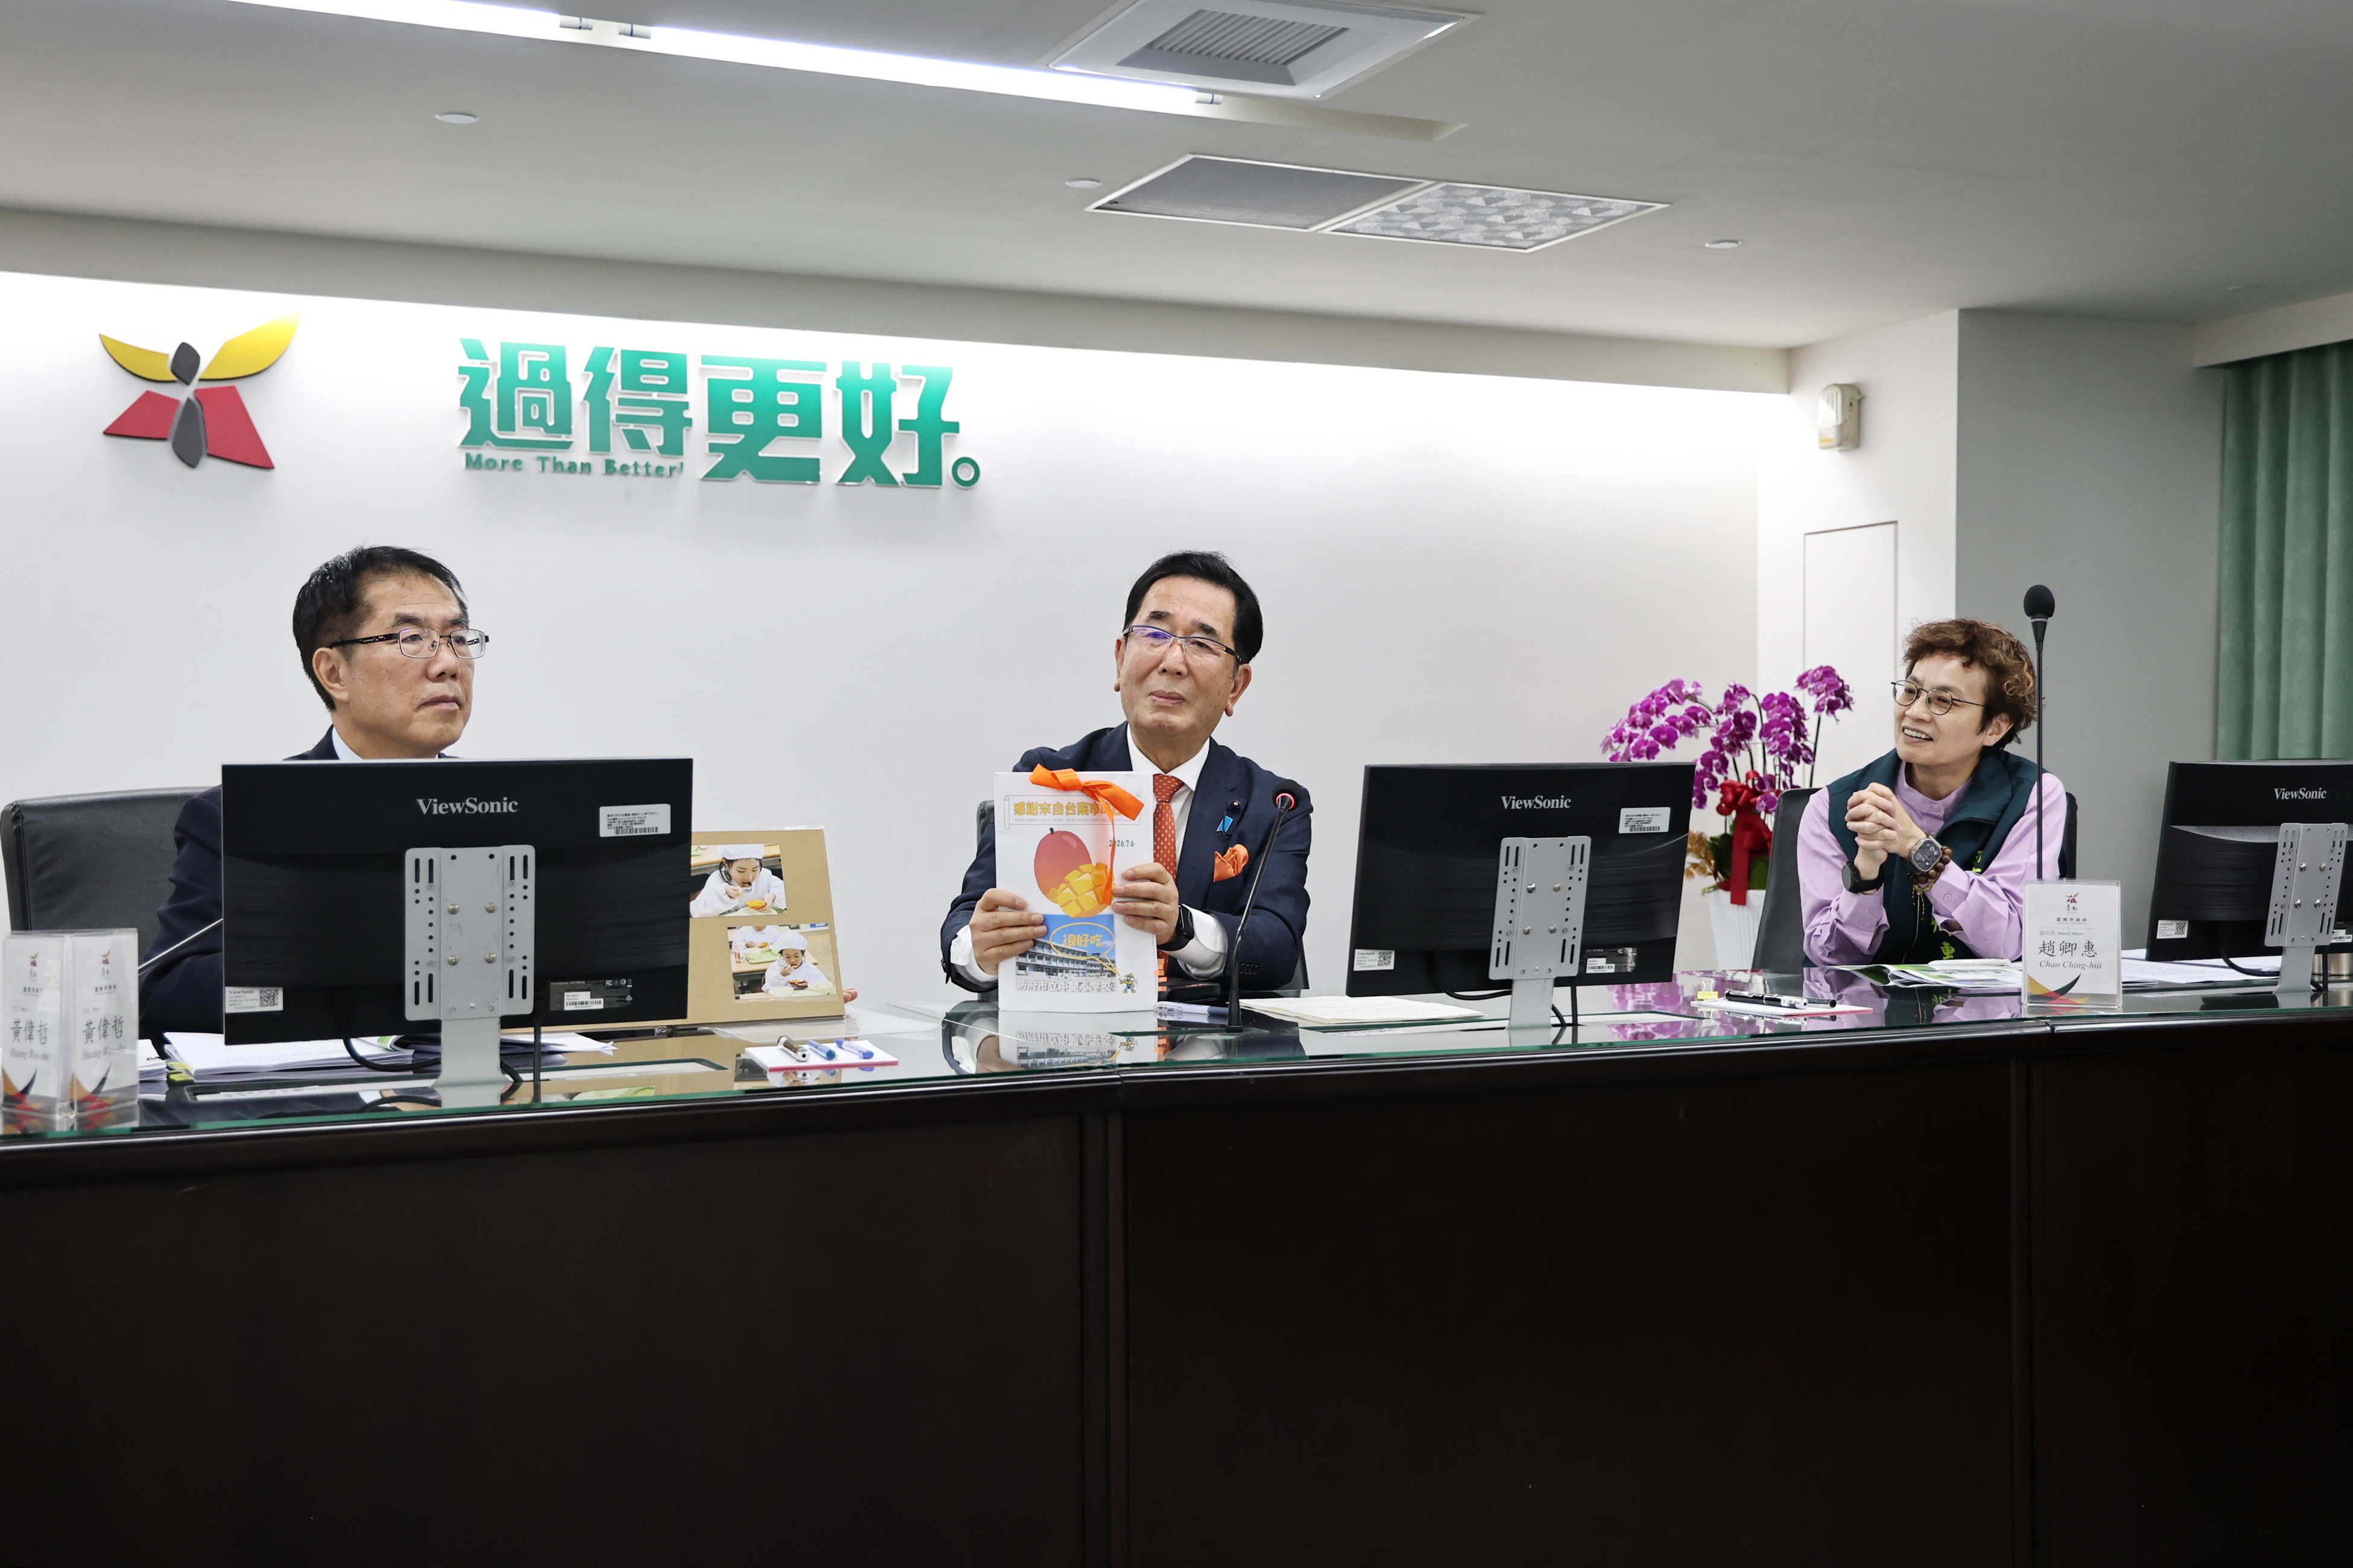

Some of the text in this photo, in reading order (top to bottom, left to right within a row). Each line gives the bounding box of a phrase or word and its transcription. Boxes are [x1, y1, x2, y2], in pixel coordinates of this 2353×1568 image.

[458, 338, 981, 488] 過得更好。
[465, 453, 522, 470] More
[537, 456, 592, 473] Than
[1501, 795, 1571, 809] ViewSonic
[2273, 787, 2327, 800] ViewSonic
[416, 797, 519, 815] ViewSonic
[1062, 934, 1103, 947] 很好吃
[2038, 940, 2098, 958] 趙卿惠
[2039, 960, 2102, 970] Chao Ching-hui
[11, 1018, 49, 1045] 黃偉哲
[83, 1015, 124, 1045] 黃偉哲
